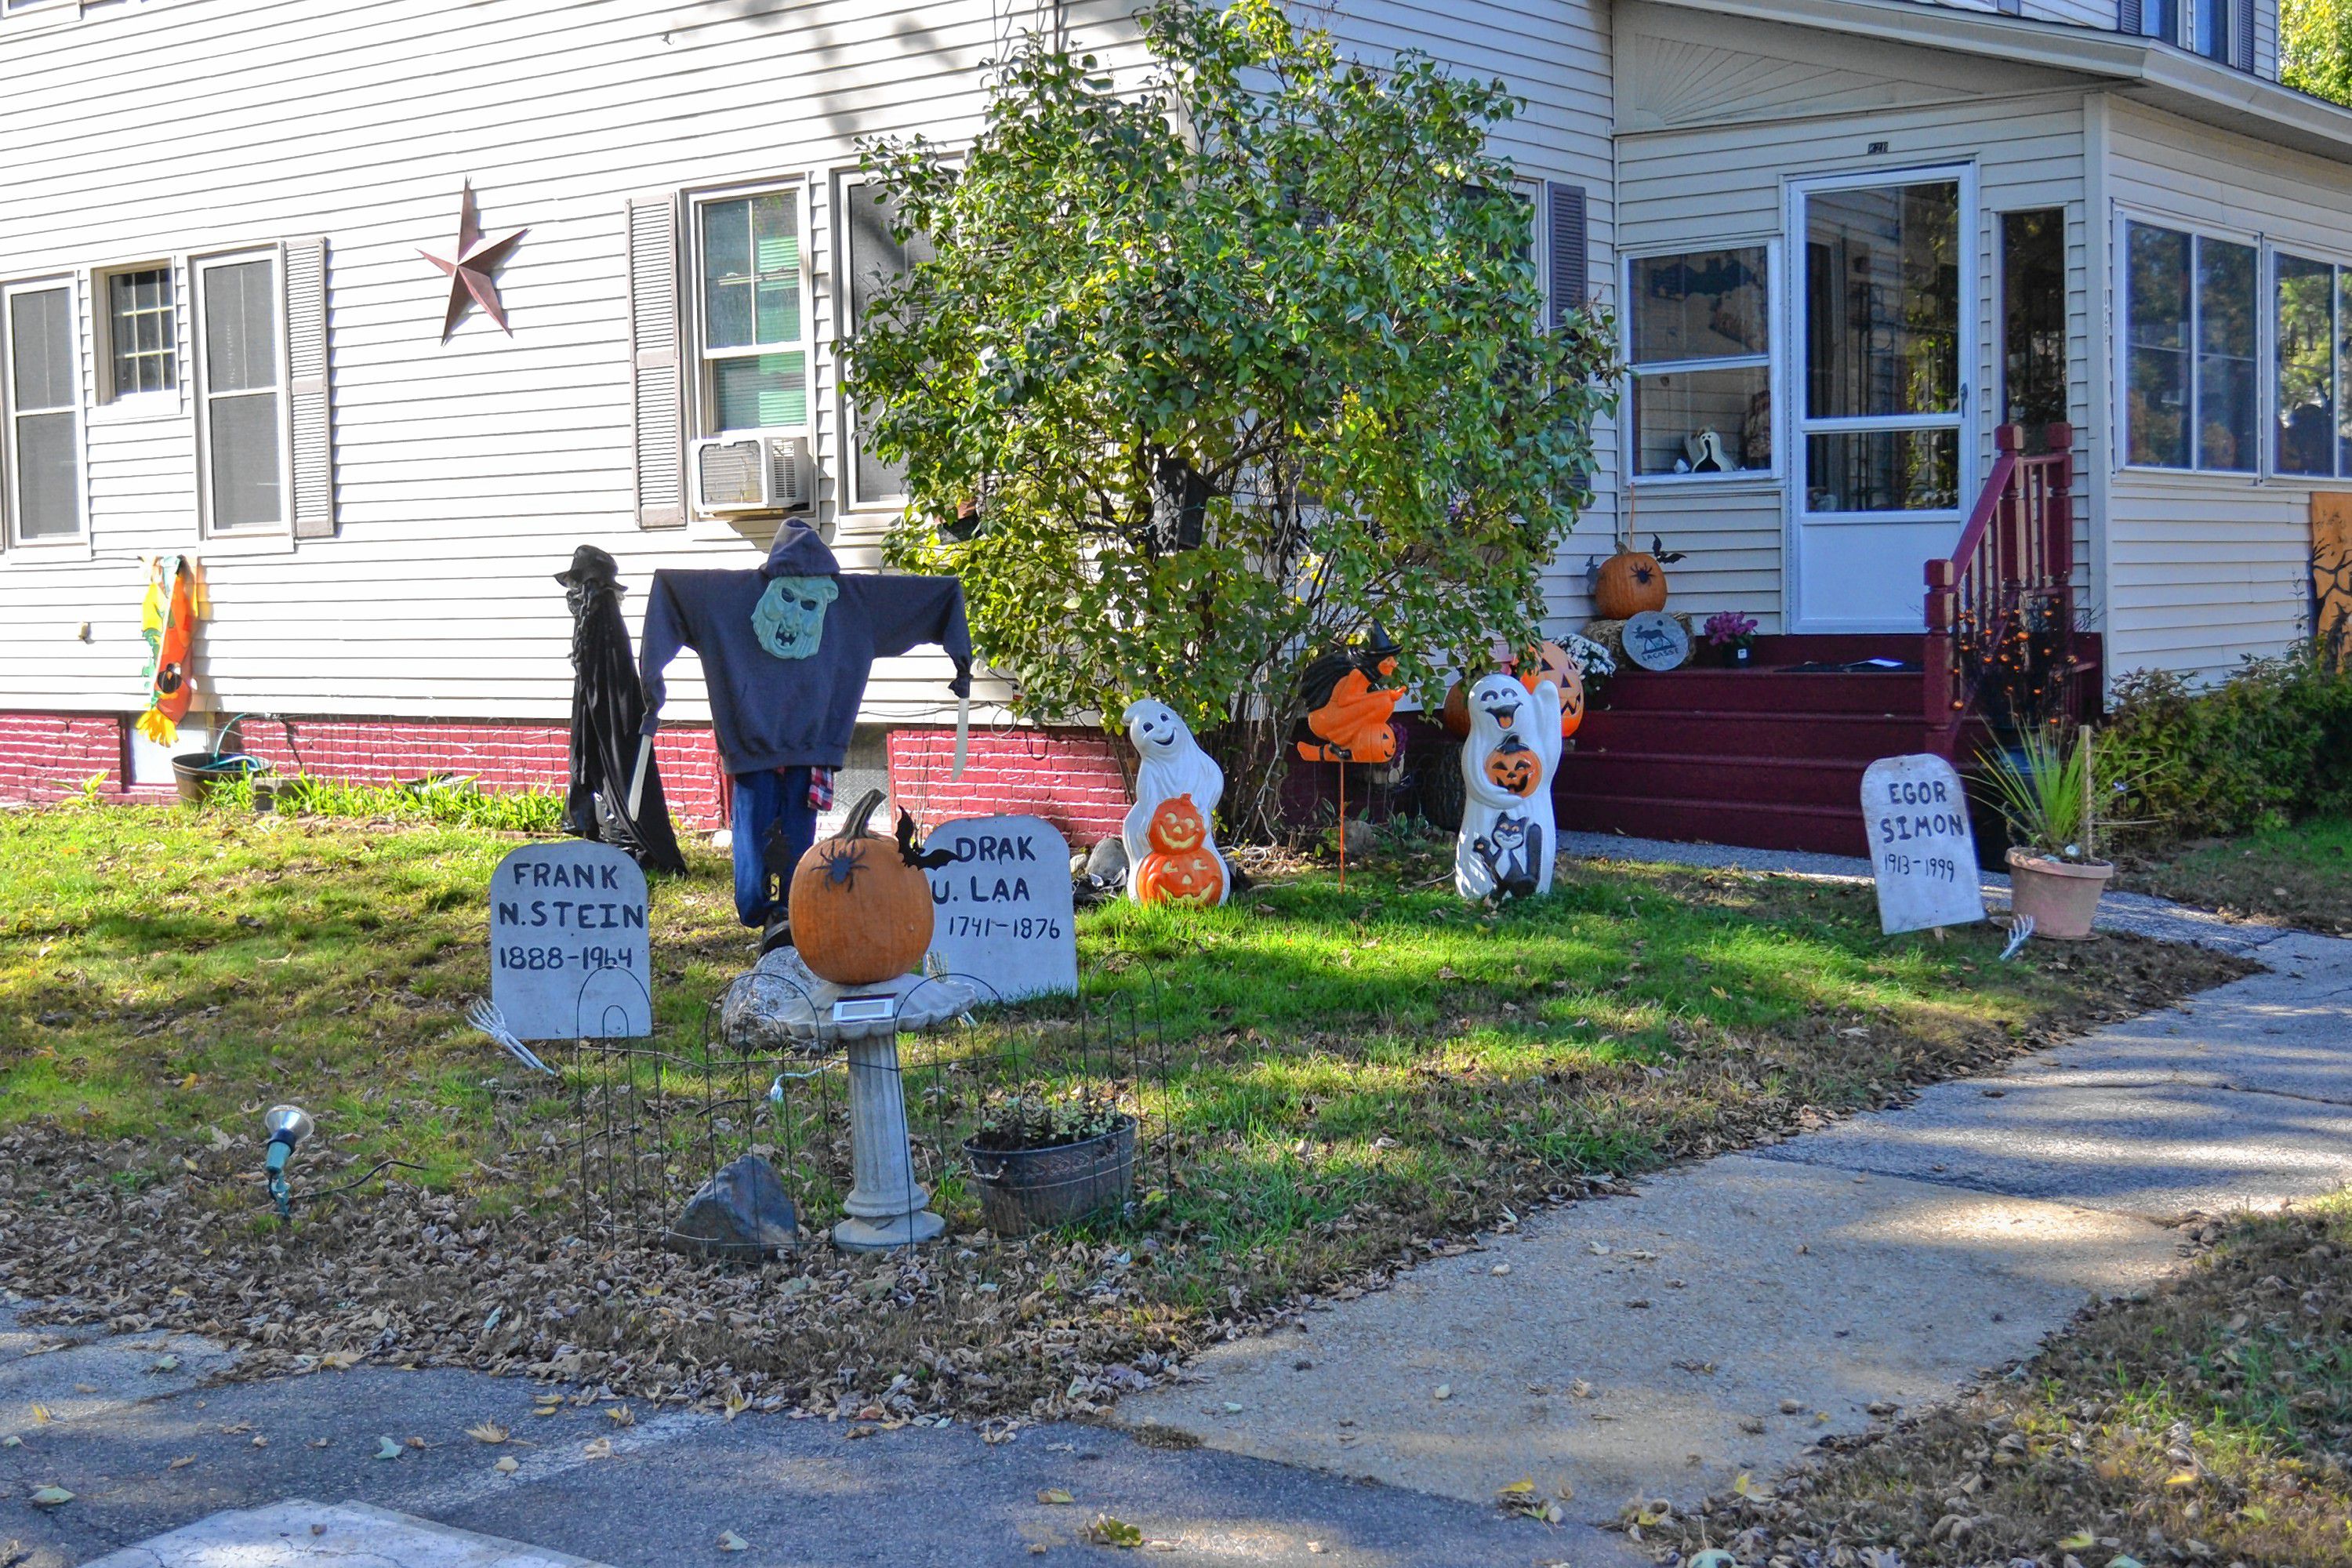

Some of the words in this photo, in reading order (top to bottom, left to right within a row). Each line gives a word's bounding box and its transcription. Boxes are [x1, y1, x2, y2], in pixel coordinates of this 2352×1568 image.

[1888, 780, 1947, 805] EGOR
[1881, 814, 1965, 844] SIMON
[956, 836, 1036, 864] DRAK
[513, 862, 619, 890] FRANK
[1885, 854, 1955, 883] 1913-1999
[931, 880, 959, 905] U.
[971, 876, 1030, 902] LAA
[499, 901, 644, 929] N.STEIN
[949, 916, 1061, 939] 1741-1876
[500, 946, 633, 970] 1888-1964
